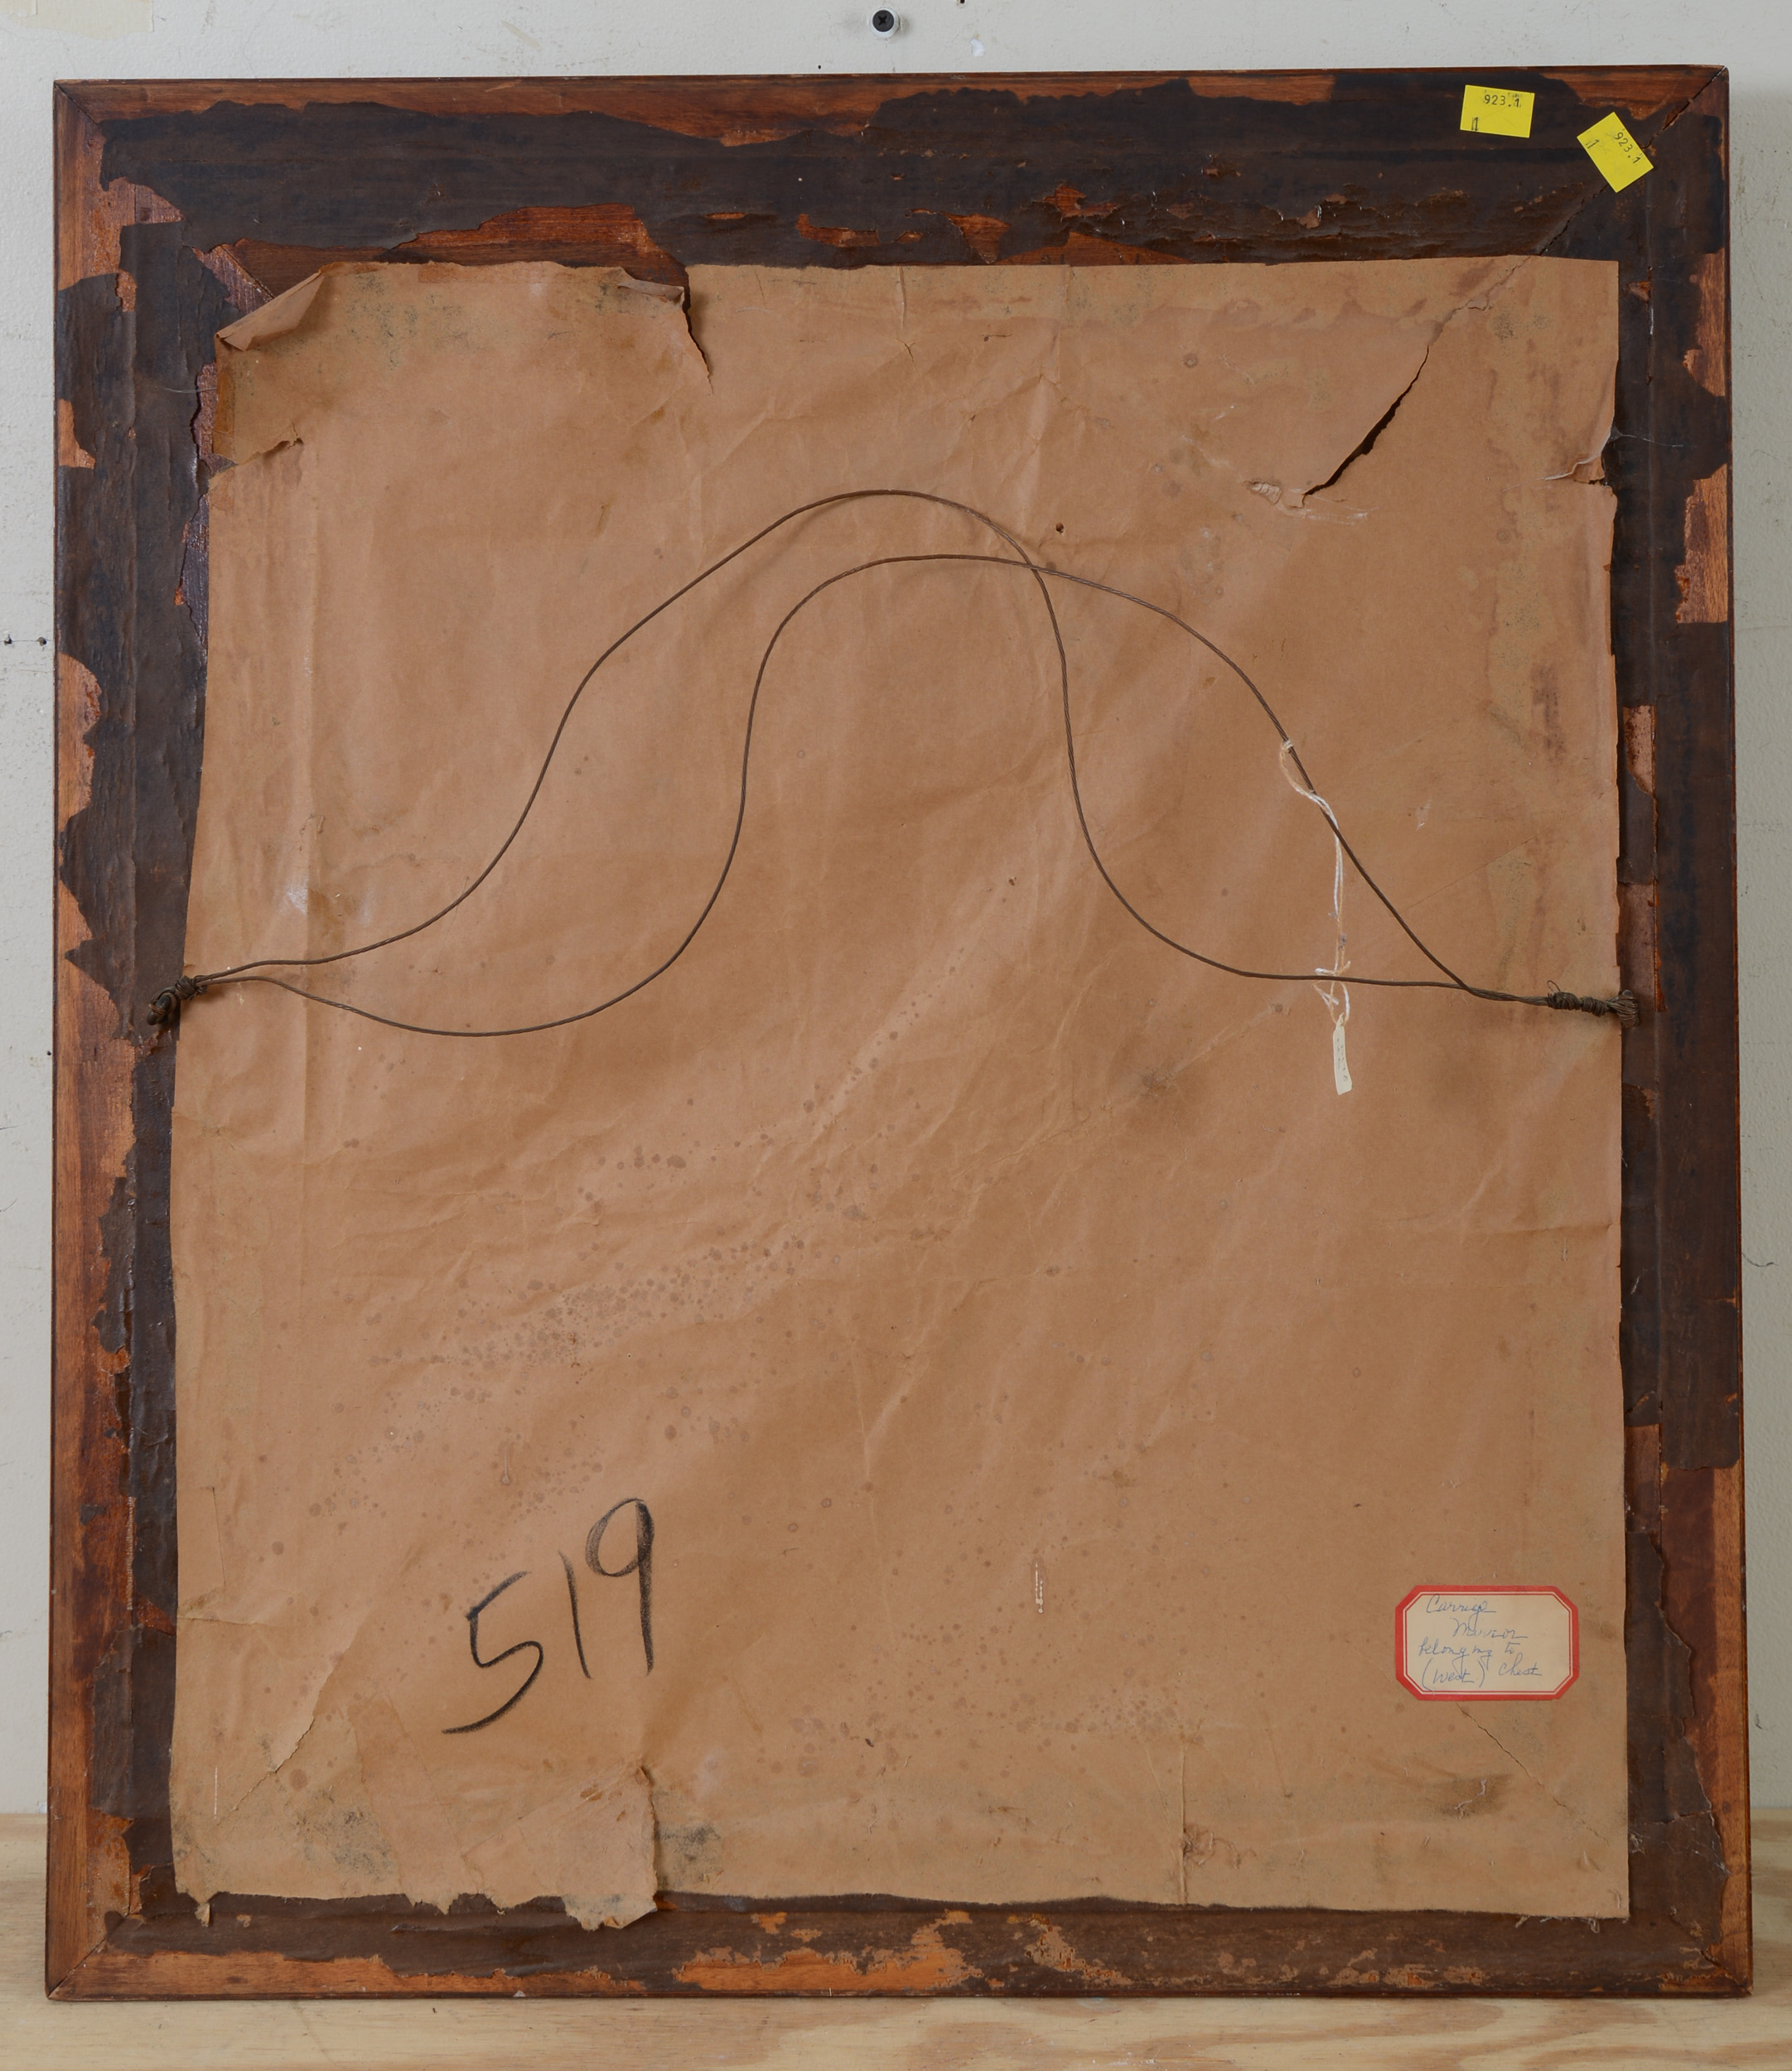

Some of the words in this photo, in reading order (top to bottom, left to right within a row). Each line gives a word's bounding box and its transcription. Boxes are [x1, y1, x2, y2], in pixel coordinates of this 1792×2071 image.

[1483, 94, 1521, 108] 923.1
[1613, 132, 1641, 164] 923.1
[442, 1497, 654, 1734] 519
[1504, 1641, 1521, 1655] to
